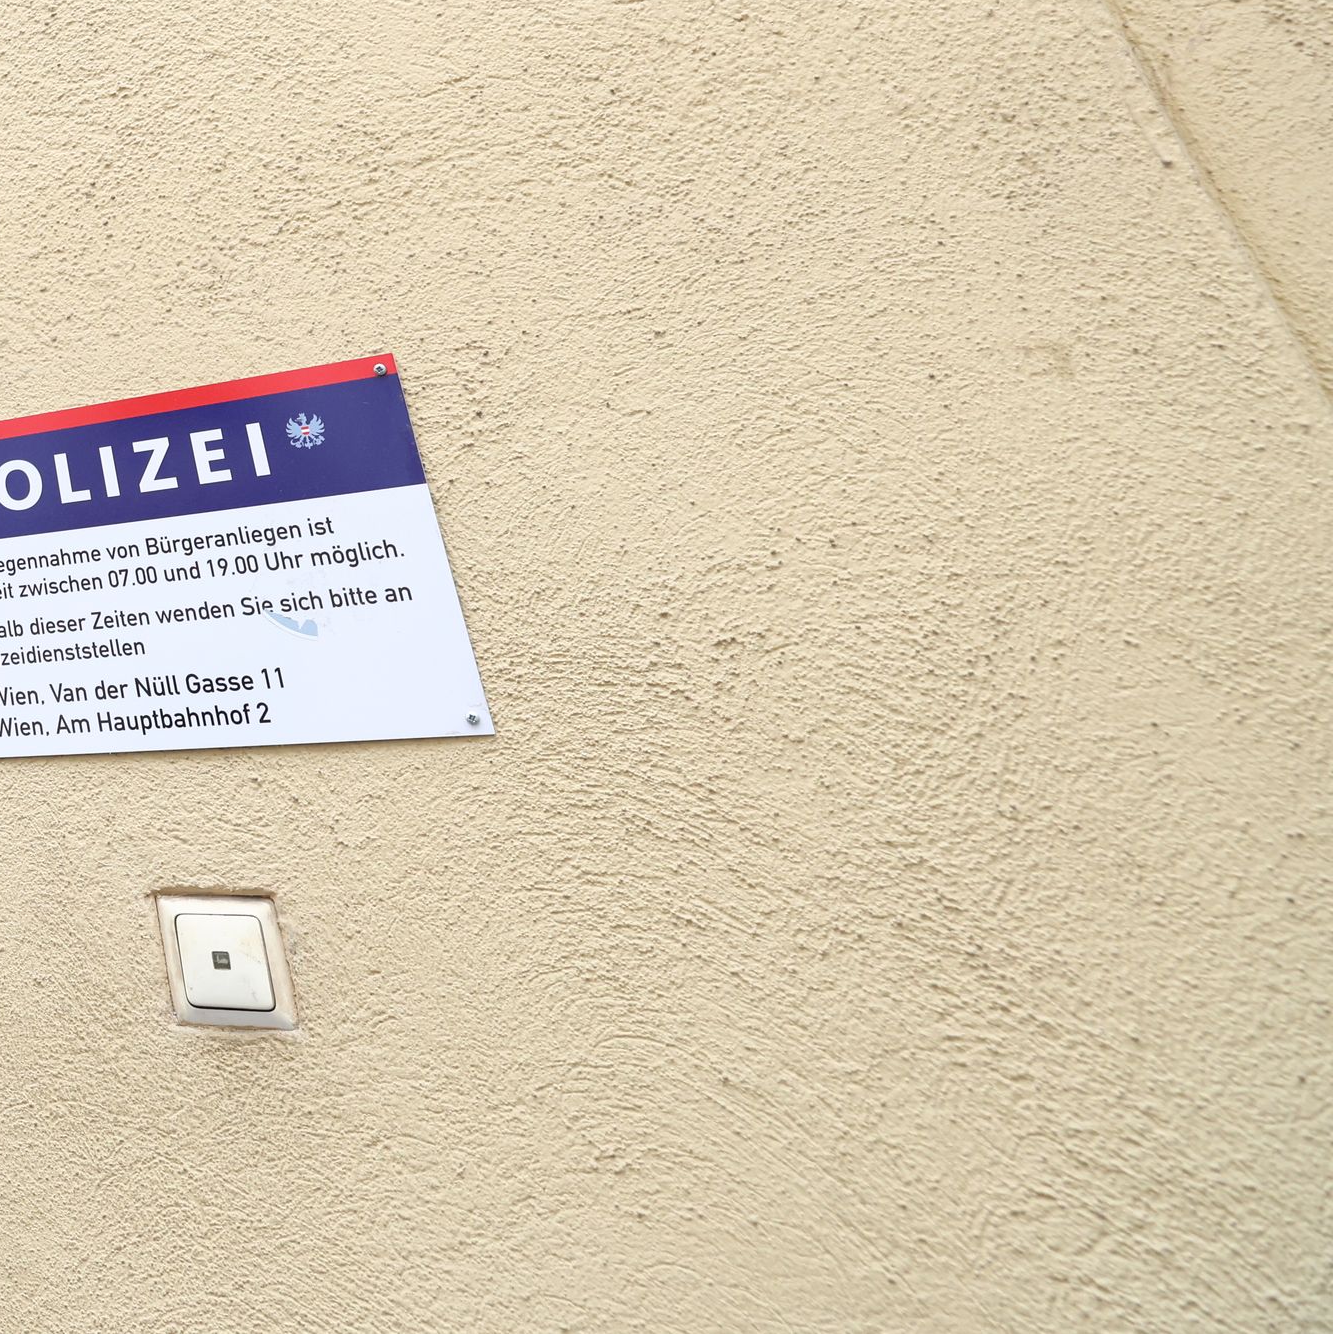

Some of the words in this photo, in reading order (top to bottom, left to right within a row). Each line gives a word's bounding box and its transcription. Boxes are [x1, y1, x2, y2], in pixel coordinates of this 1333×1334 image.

[105, 544, 141, 560] von
[144, 524, 302, 557] Bürgeranliegen
[306, 516, 335, 537] ist
[18, 574, 103, 598] zwischen
[107, 565, 158, 588] 07.00
[163, 560, 202, 583] und
[206, 554, 259, 578] 19.00
[263, 550, 304, 572] Uhr
[310, 539, 405, 568] möglich.
[29, 616, 86, 636] dieser
[90, 609, 151, 630] Zeiten
[154, 600, 236, 624] wenden
[240, 595, 274, 616] Sie
[279, 590, 324, 613] sich
[328, 587, 378, 608] bitte
[384, 586, 413, 603] an
[48, 682, 88, 703] Van
[94, 679, 129, 701] der
[134, 674, 181, 698] Nüll
[185, 673, 255, 695] Gasse
[260, 667, 285, 690] 11
[56, 714, 91, 735] Am
[96, 702, 251, 736] Hauptbahnhof
[256, 701, 272, 724] 2
